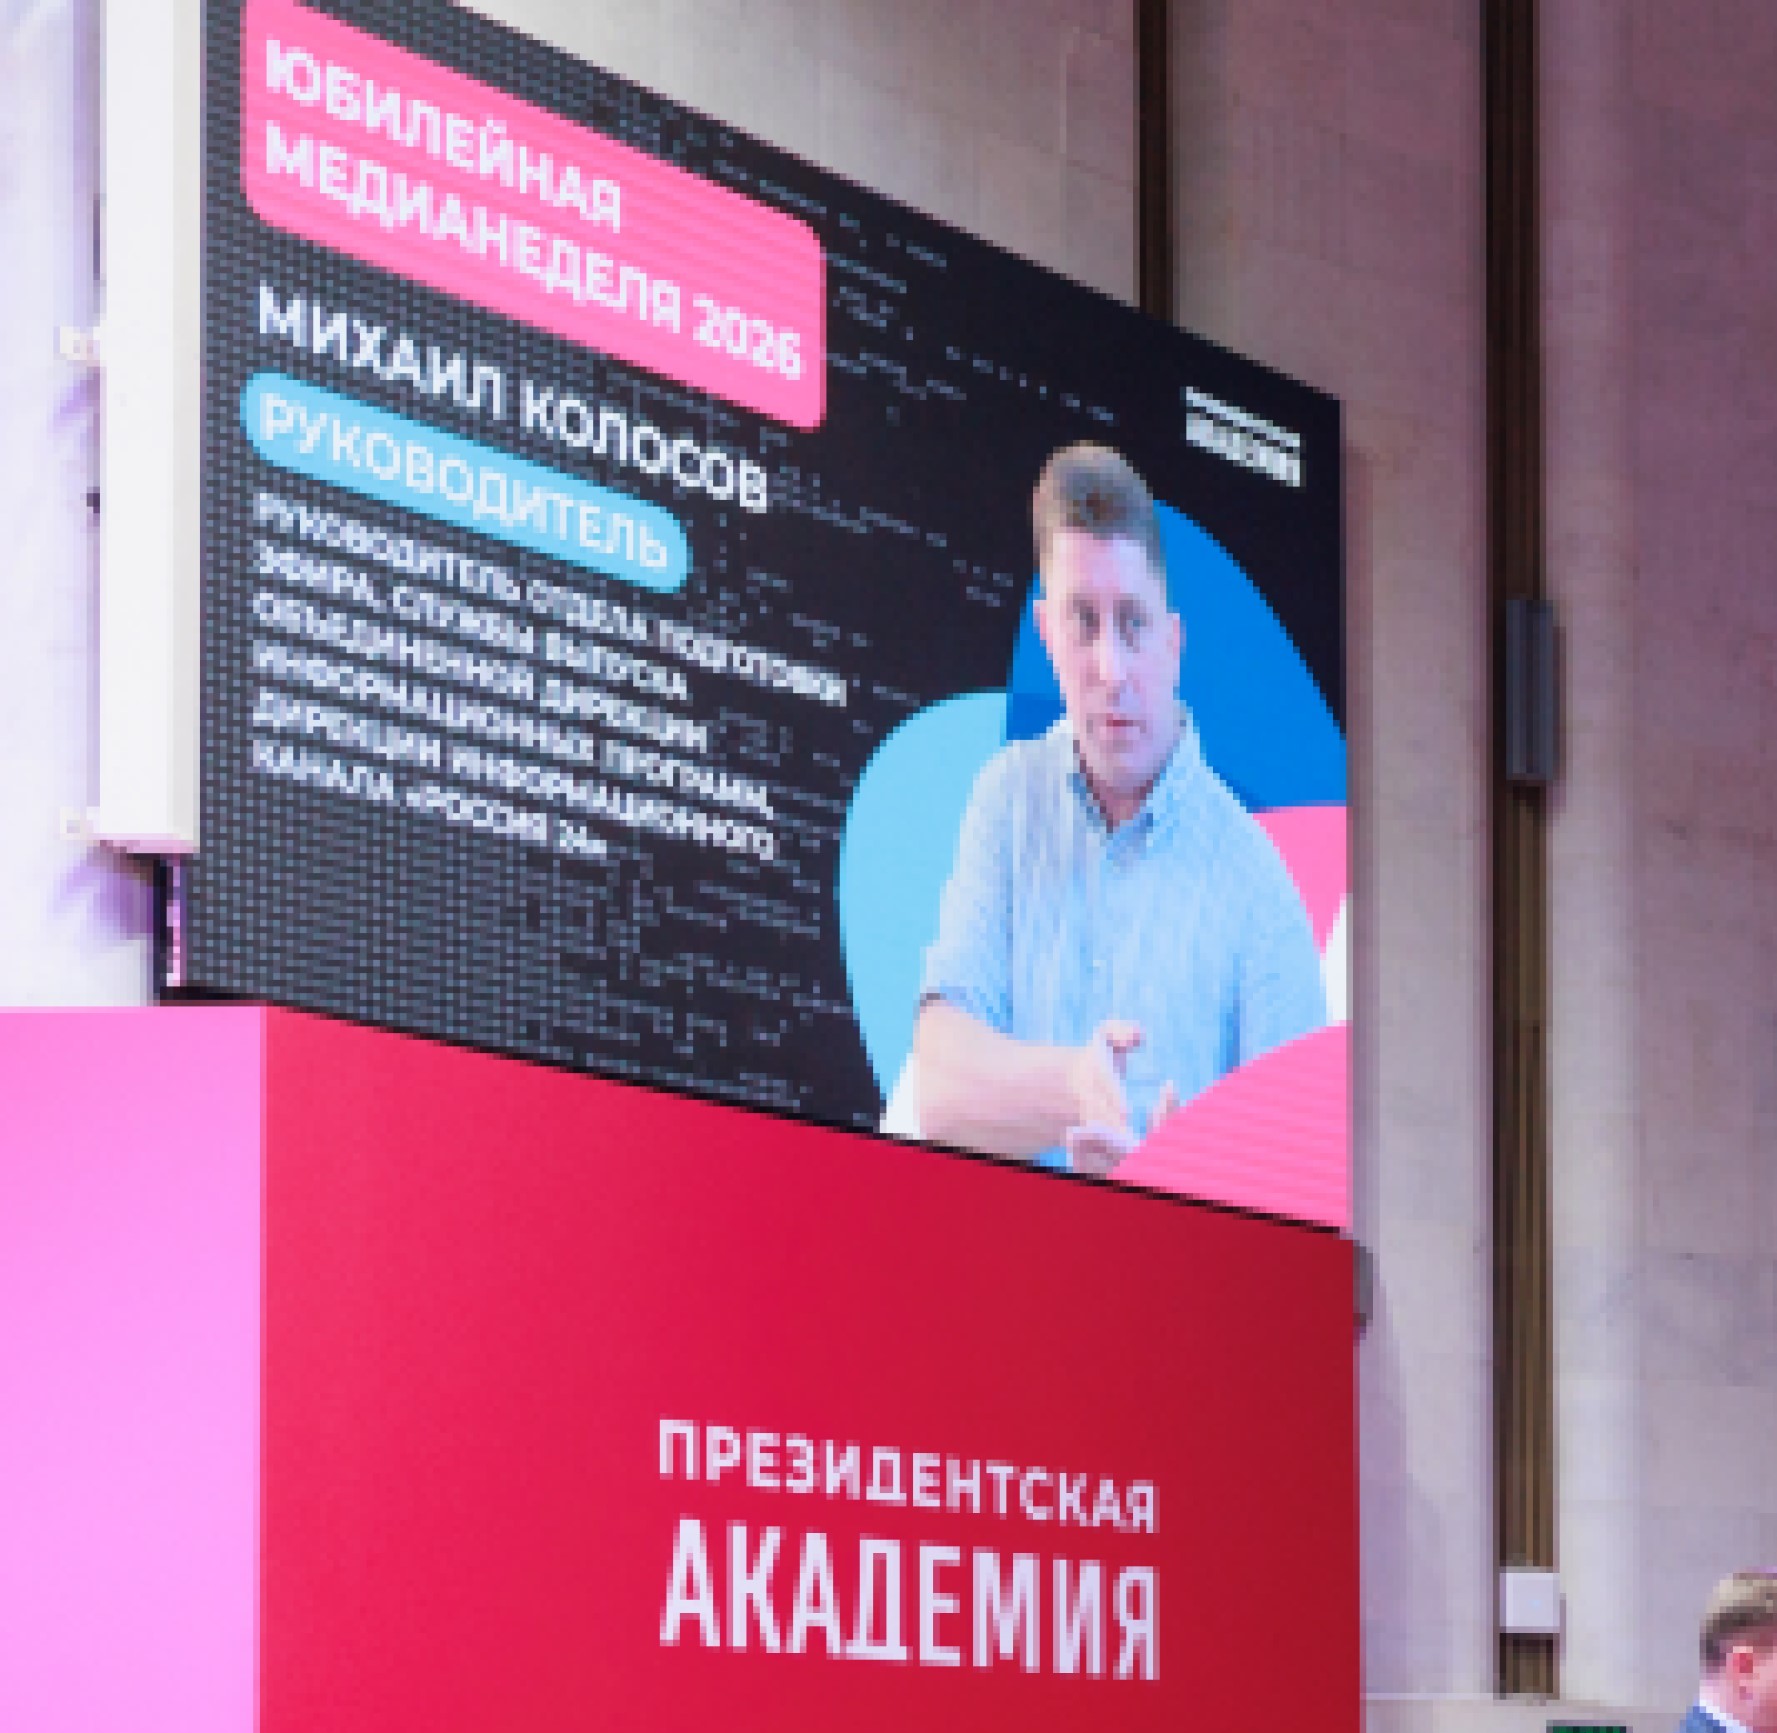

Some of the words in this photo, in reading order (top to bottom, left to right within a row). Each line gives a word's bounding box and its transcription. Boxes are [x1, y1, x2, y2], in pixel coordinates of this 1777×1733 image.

[265, 39, 621, 232] ЮБИЛЕЙНАЯ
[265, 120, 681, 333] МЕДИАНЕДЕЛЯ
[692, 298, 804, 381] 2026
[259, 281, 501, 420] МИХАИЛ
[519, 380, 768, 514] КОЛОСОВ
[260, 392, 668, 569] РУКОВОДИТЕЛЬ
[253, 493, 520, 601] РУКОВОДИТЕЛЬ
[659, 1415, 1160, 1534] ПРЕЗИДЕНТСКАЯ
[660, 1514, 1160, 1680] АКАДЕМИЯ
